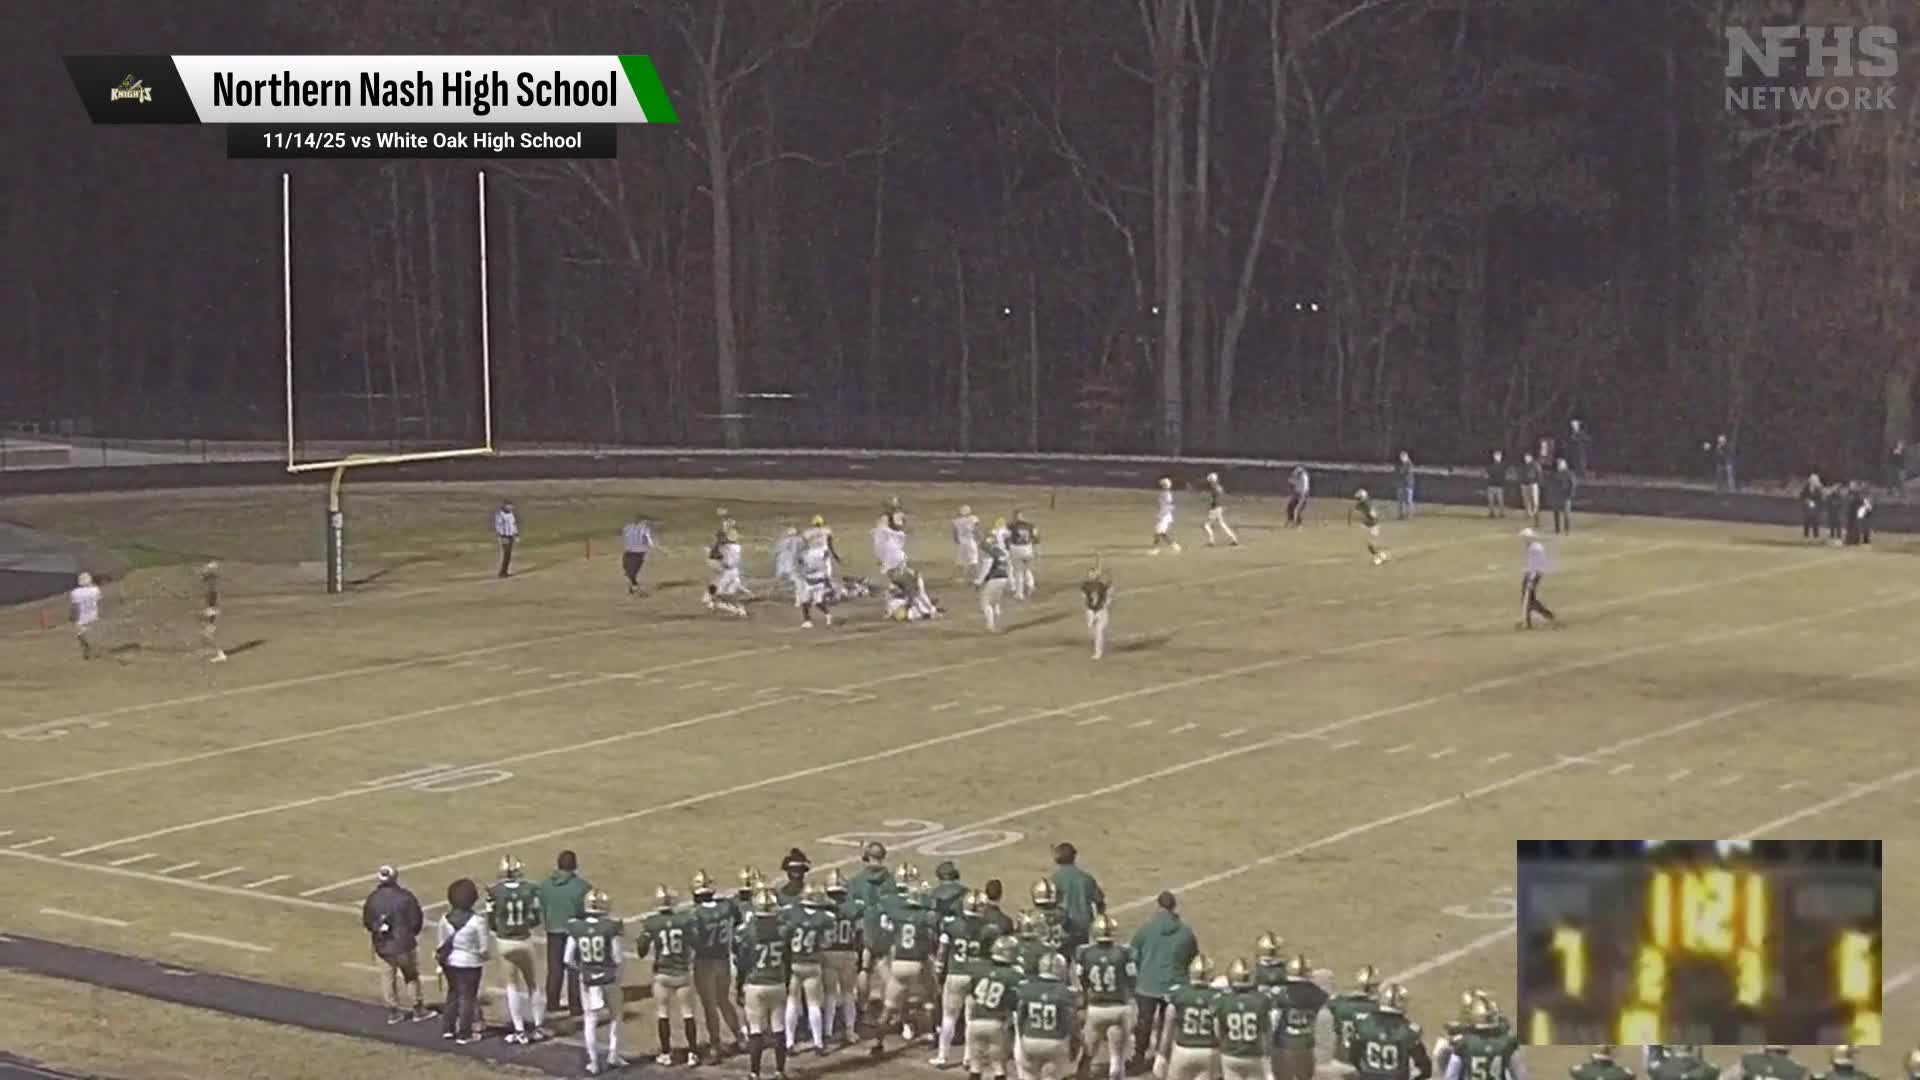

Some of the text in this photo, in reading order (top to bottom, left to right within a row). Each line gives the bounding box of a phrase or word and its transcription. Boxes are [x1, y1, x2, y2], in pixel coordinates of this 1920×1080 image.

[816, 818, 1024, 855] 20
[505, 900, 524, 925] 11
[578, 936, 605, 962] 88
[901, 923, 916, 949] 8
[755, 941, 783, 969] 75
[1089, 965, 1117, 992] 44
[973, 978, 1005, 1008] 48
[1028, 1002, 1057, 1030] 50
[1227, 1012, 1258, 1041] 86
